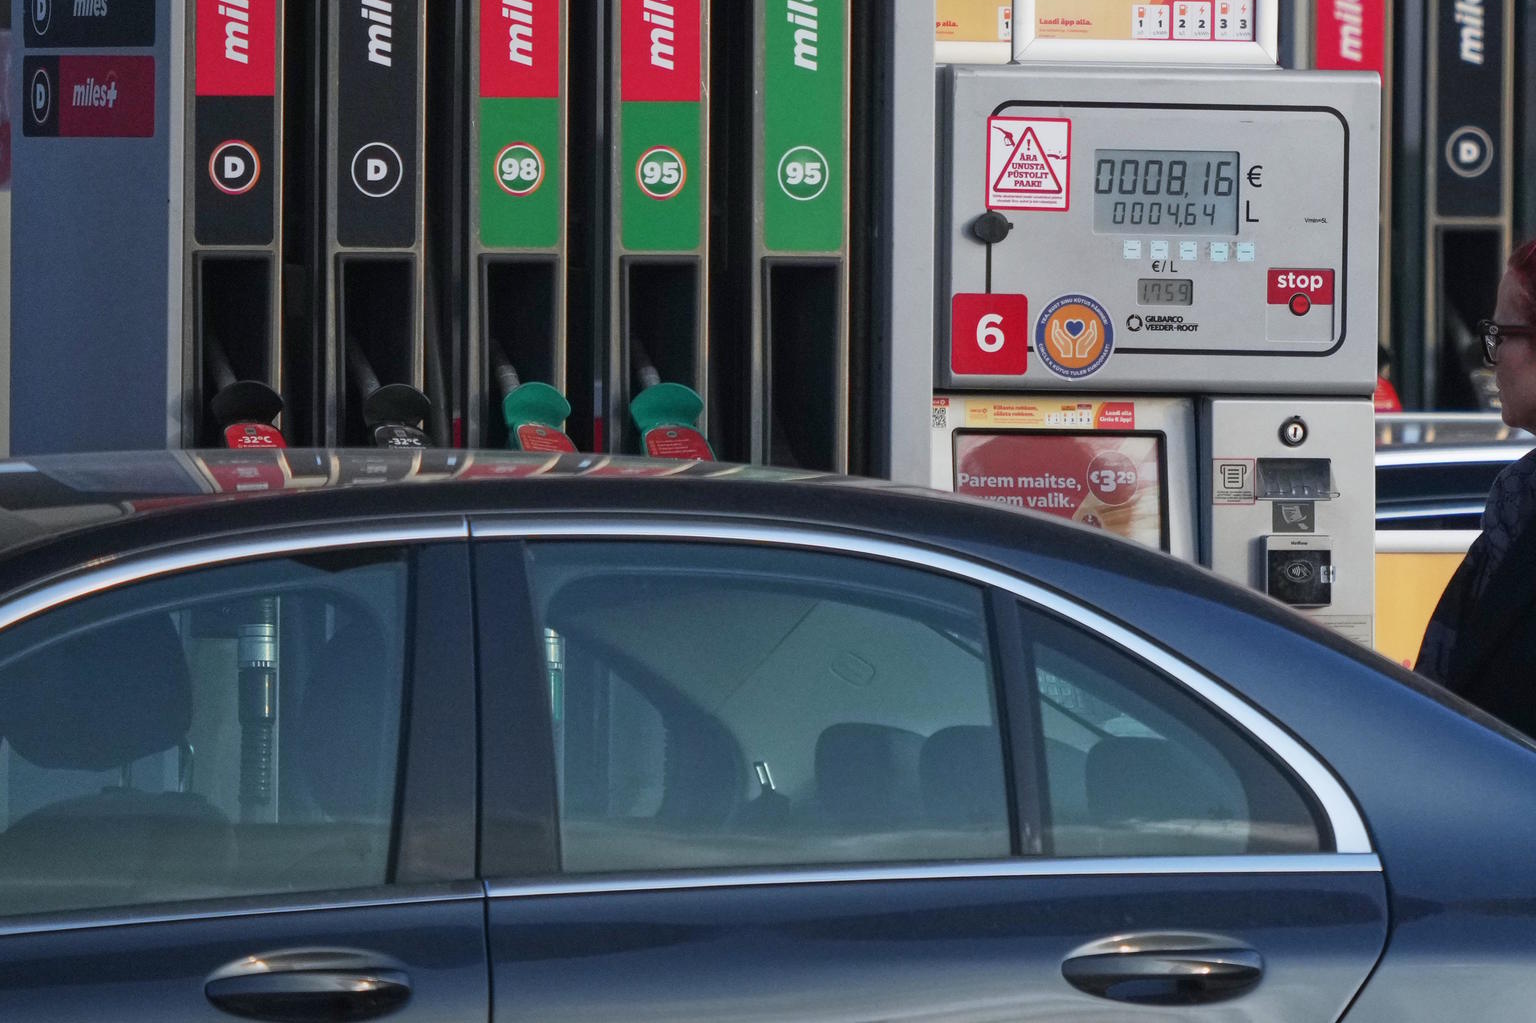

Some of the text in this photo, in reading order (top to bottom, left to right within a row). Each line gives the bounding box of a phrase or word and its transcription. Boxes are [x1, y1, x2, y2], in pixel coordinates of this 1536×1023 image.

[1179, 19, 1186, 28] 2
[1198, 20, 1205, 28] 2
[1220, 19, 1228, 29] 3
[1240, 19, 1247, 29] 3
[36, 83, 46, 110] D
[1020, 153, 1037, 161] ÄRA
[223, 156, 245, 179] D
[367, 159, 388, 181] D
[500, 158, 538, 182] 98
[642, 161, 680, 185] 95
[784, 162, 821, 185] 95
[1008, 170, 1049, 179] PÜSTOLIT
[1247, 165, 1263, 187] €
[1113, 201, 1259, 228] 0004,64 L
[1277, 273, 1323, 290] stop
[976, 314, 1005, 352] 6
[1145, 324, 1198, 332] VEEDER-ROOT
[958, 473, 1082, 491] Parem maitse,
[1028, 493, 1075, 508] valik.
